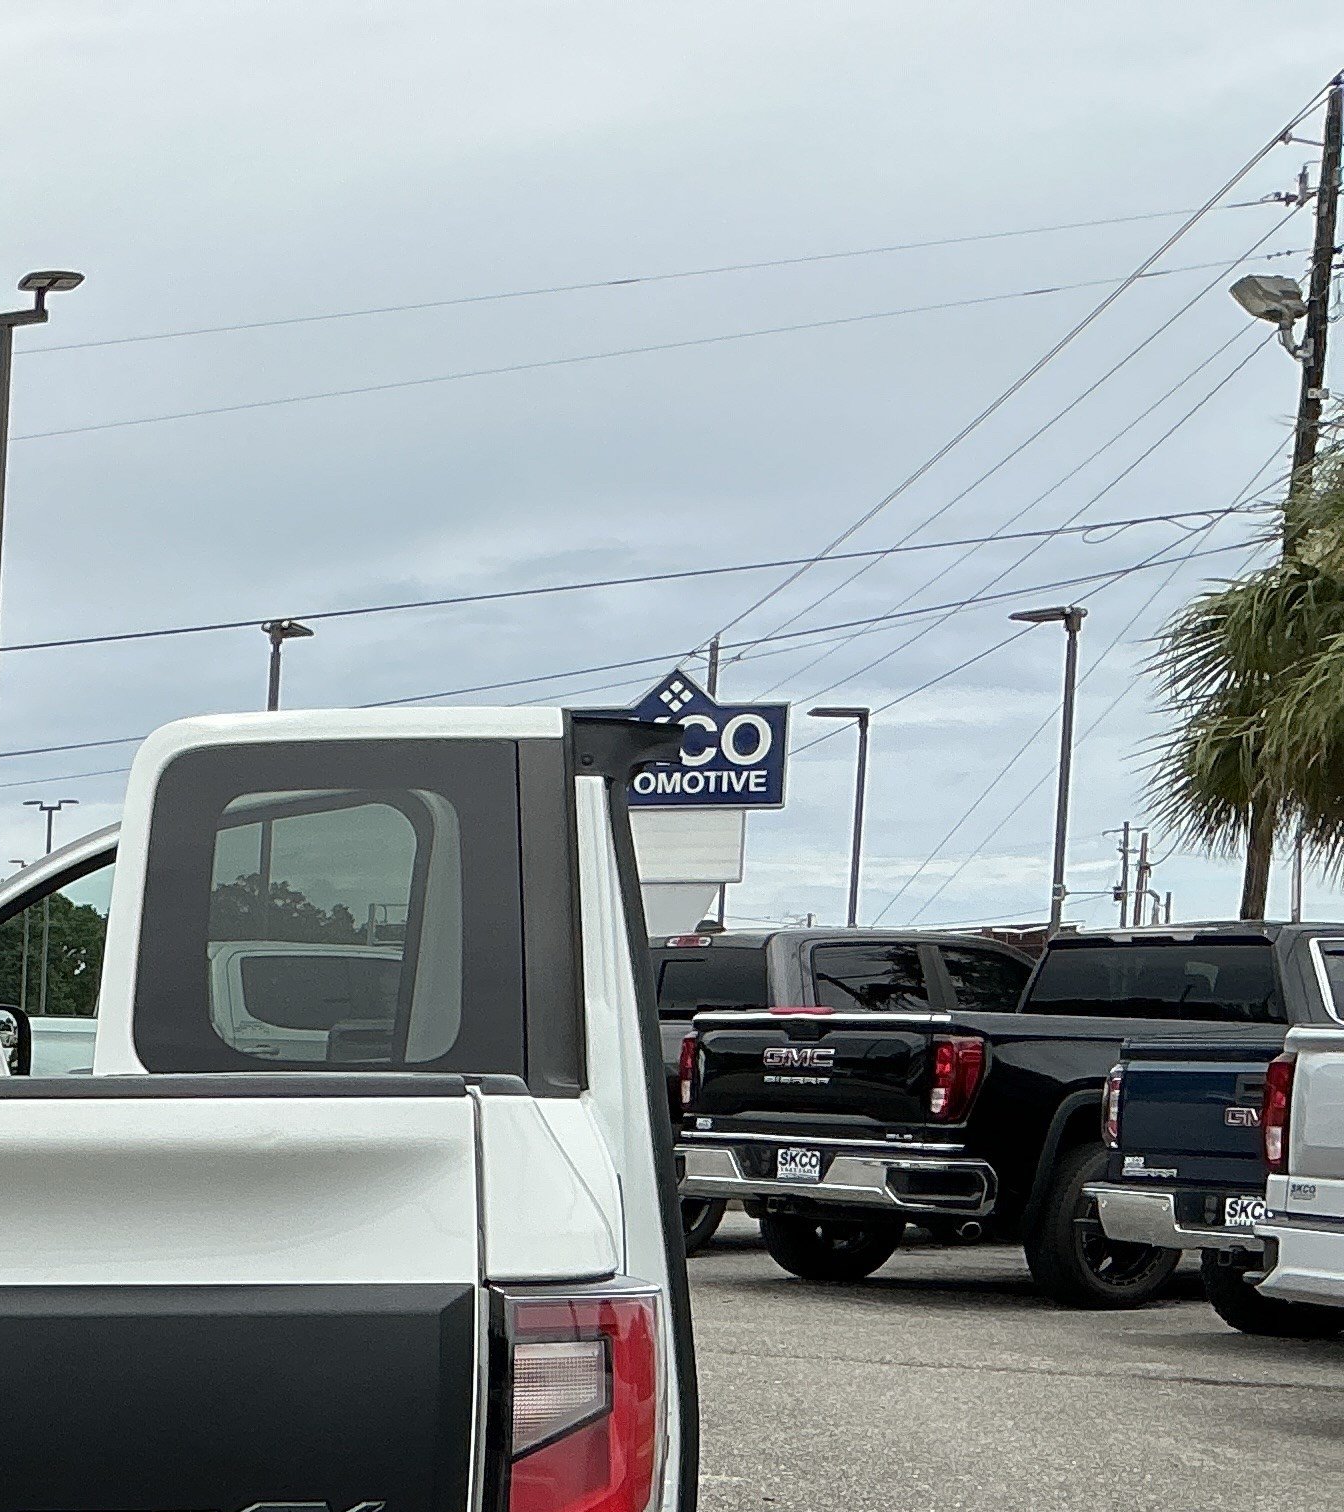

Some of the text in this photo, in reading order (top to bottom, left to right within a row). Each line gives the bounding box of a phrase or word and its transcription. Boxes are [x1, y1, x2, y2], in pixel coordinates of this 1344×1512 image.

[632, 770, 768, 795] OMOTIVE
[763, 1047, 836, 1068] GMC
[1225, 1107, 1262, 1127] GM
[778, 1150, 820, 1169] SKCO
